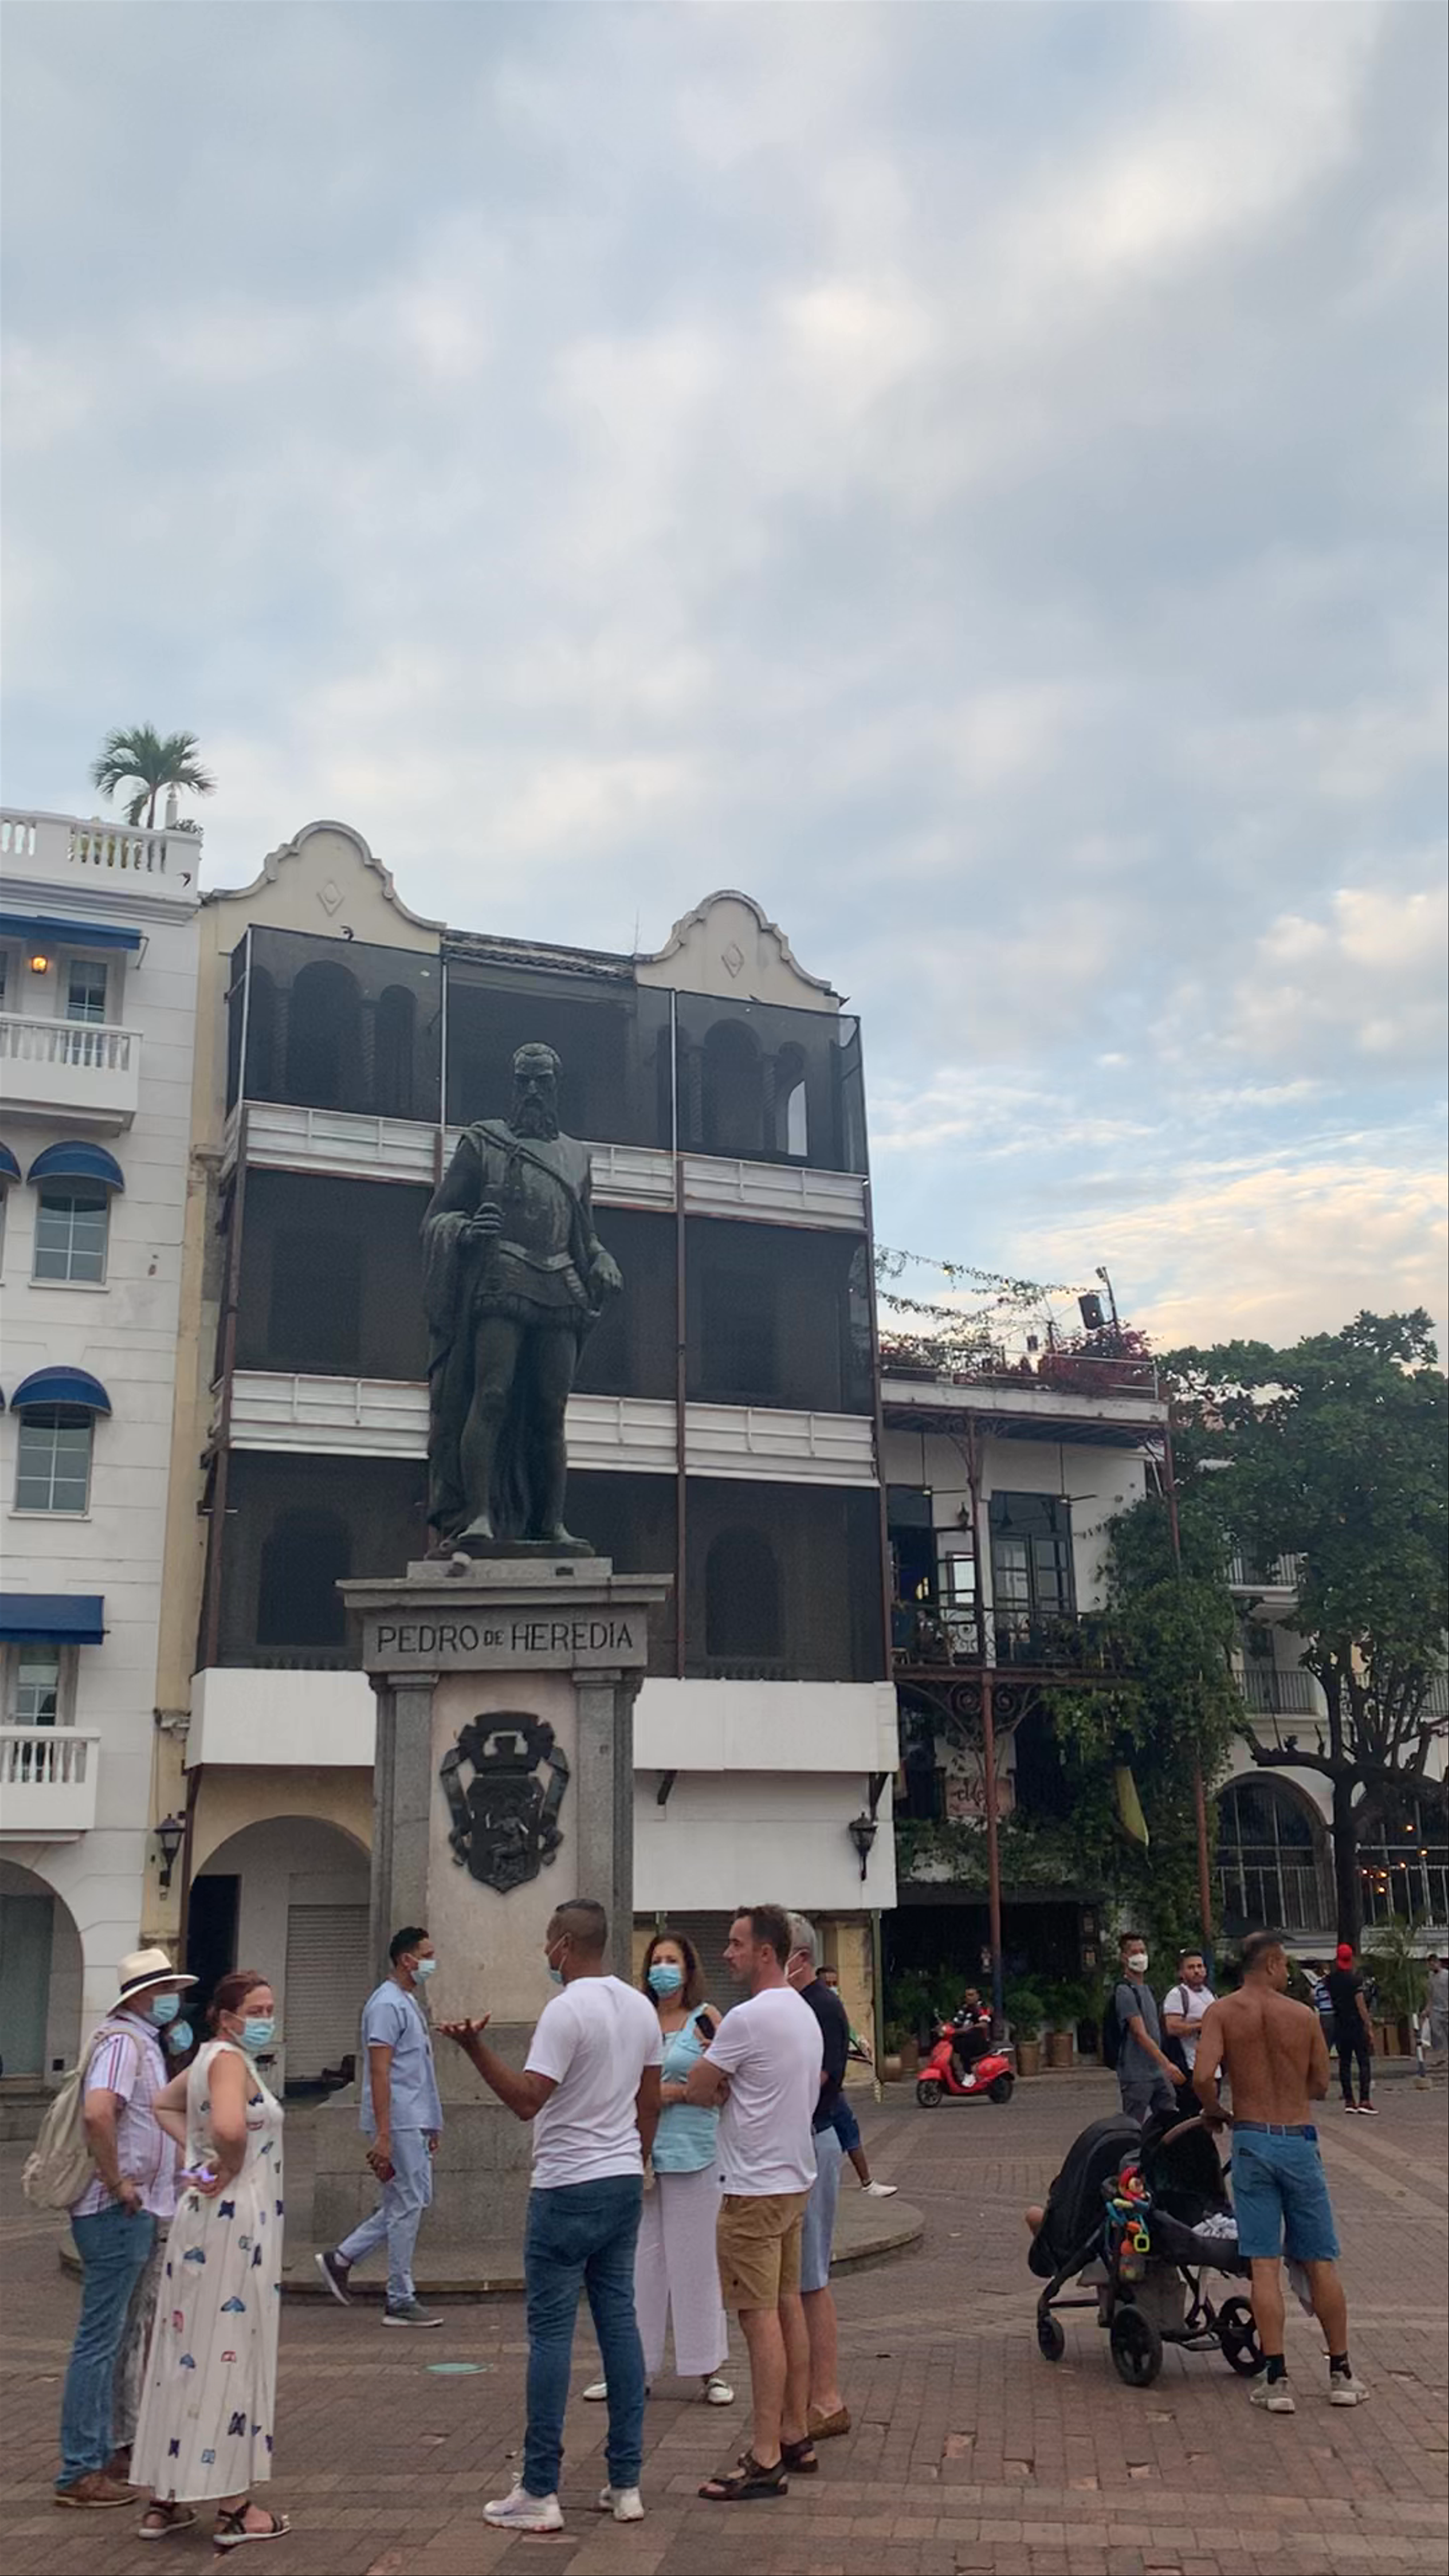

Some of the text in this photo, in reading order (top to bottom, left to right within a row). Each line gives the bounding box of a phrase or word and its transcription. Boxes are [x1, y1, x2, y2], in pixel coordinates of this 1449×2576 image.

[378, 1622, 633, 1653] PEDRO DE HEREDIA
